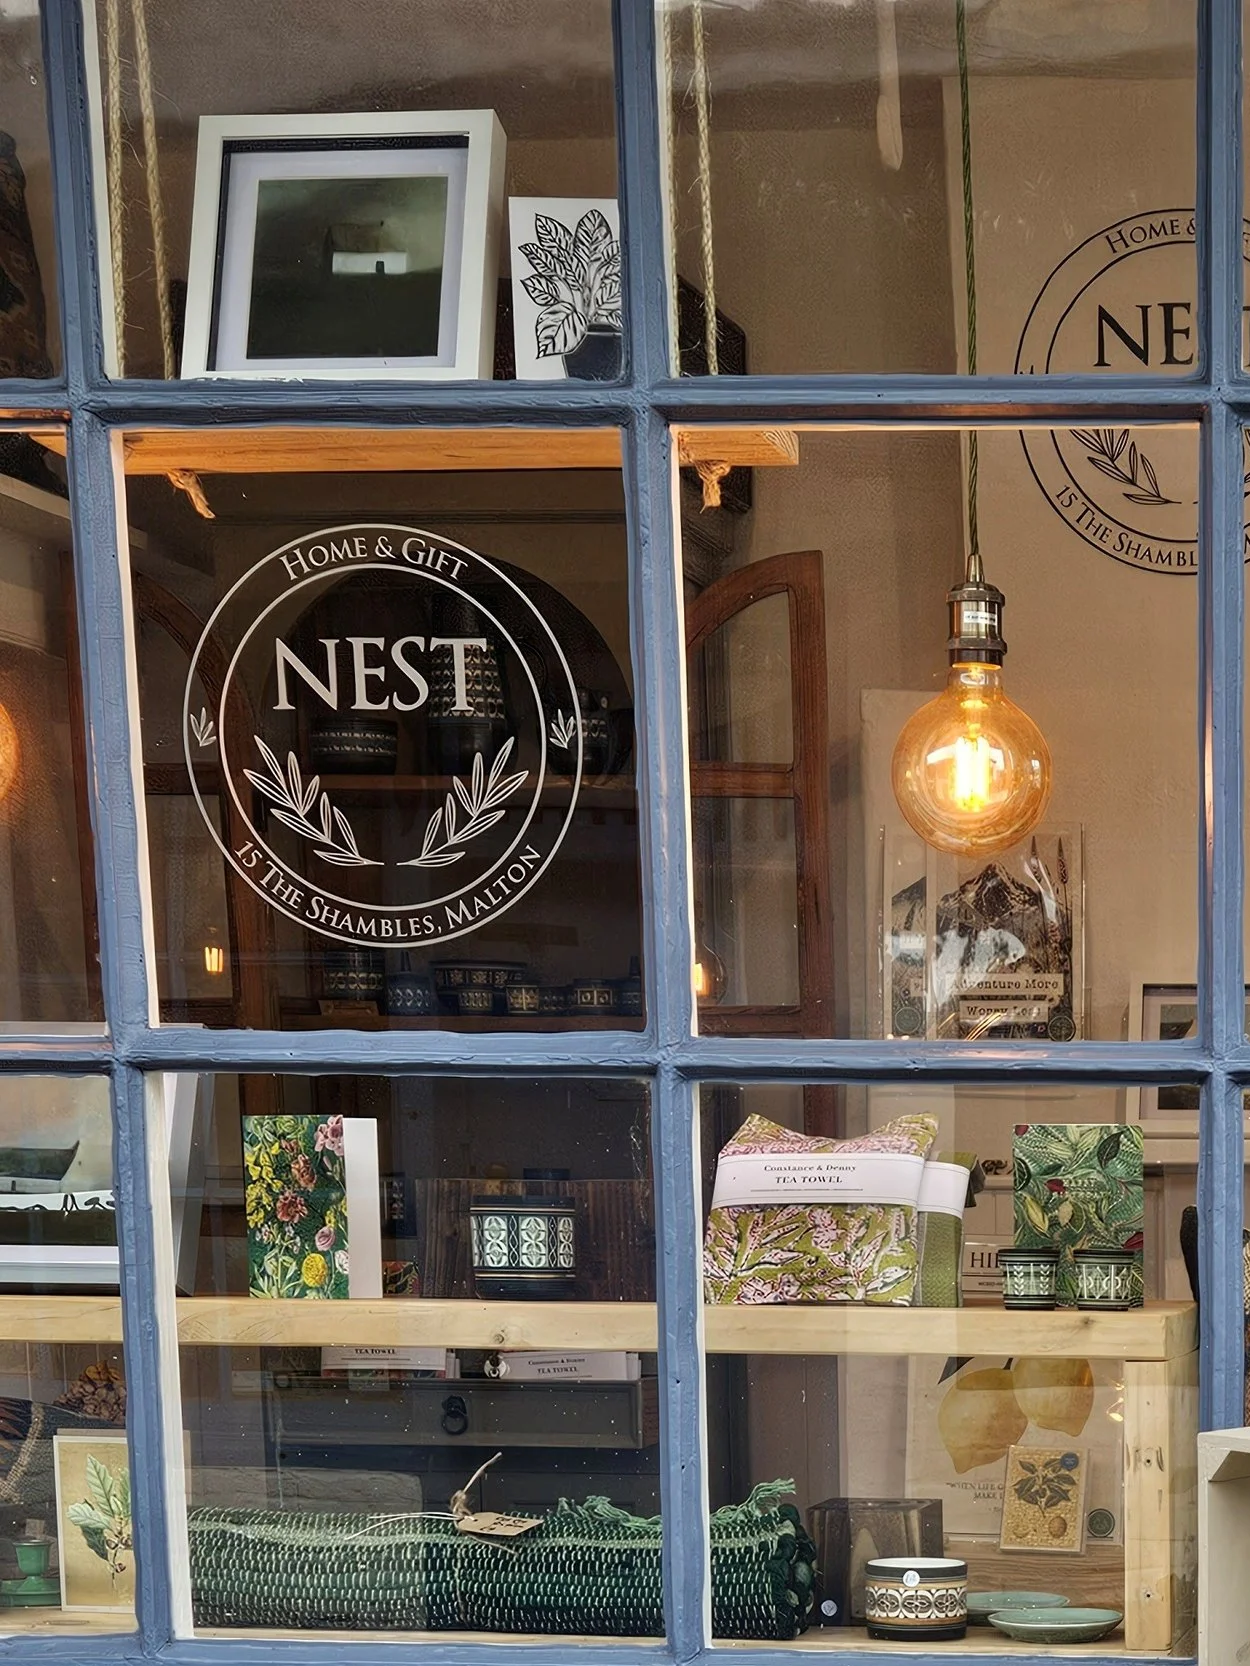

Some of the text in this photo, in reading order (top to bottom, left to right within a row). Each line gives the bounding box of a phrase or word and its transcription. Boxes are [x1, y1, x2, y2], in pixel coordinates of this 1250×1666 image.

[1105, 219, 1181, 254] HOME
[1055, 484, 1079, 508] 15
[1074, 502, 1113, 544] THE
[1113, 532, 1198, 567] SHAMBL
[279, 535, 469, 580] HOME & GIFT
[272, 636, 487, 712] NEST
[234, 840, 541, 938] 15 THE SHAMBLES, MALTON
[1025, 979, 1058, 989] More
[775, 1175, 843, 1184] TEA TOWEL
